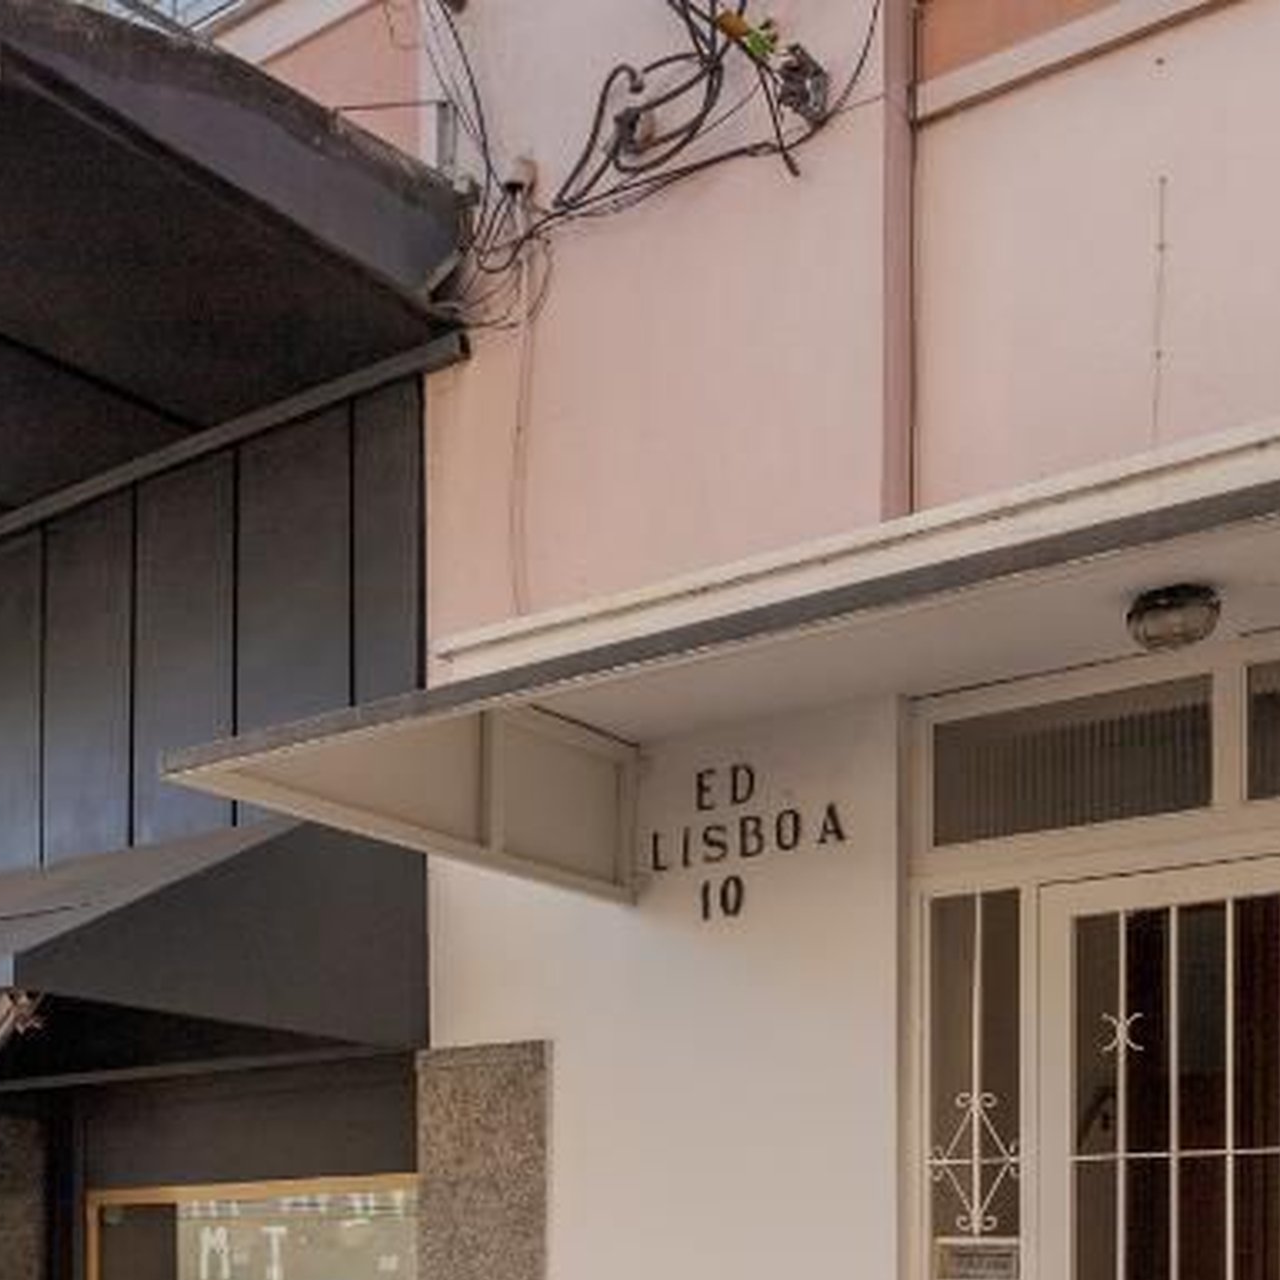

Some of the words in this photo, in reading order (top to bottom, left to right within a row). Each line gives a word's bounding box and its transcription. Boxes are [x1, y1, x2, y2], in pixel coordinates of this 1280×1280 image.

[695, 763, 756, 811] ED
[651, 803, 846, 872] LISBOA
[701, 875, 744, 920] 10
